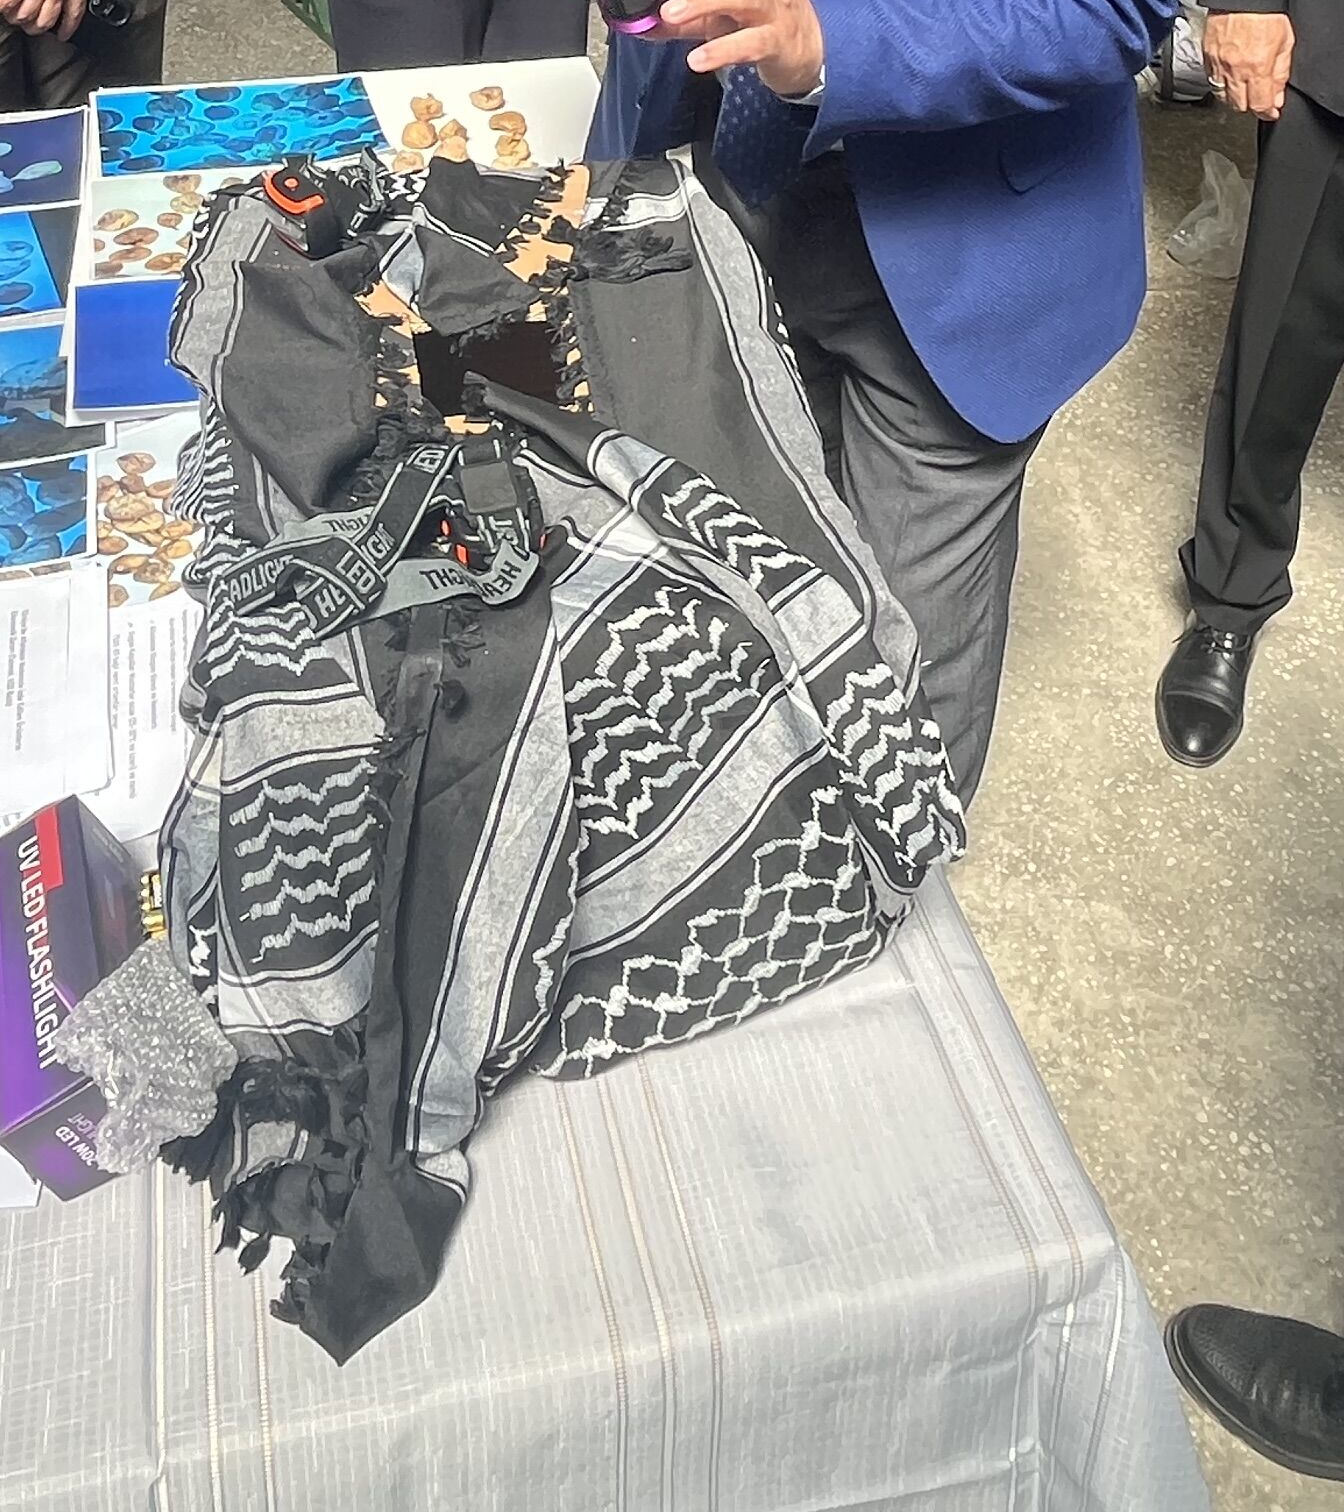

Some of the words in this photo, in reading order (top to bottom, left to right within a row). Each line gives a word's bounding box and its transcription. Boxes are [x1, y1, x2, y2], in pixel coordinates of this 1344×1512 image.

[17, 835, 39, 871] UV
[21, 871, 46, 919] LED
[25, 916, 58, 1071] FLASHLIGHT
